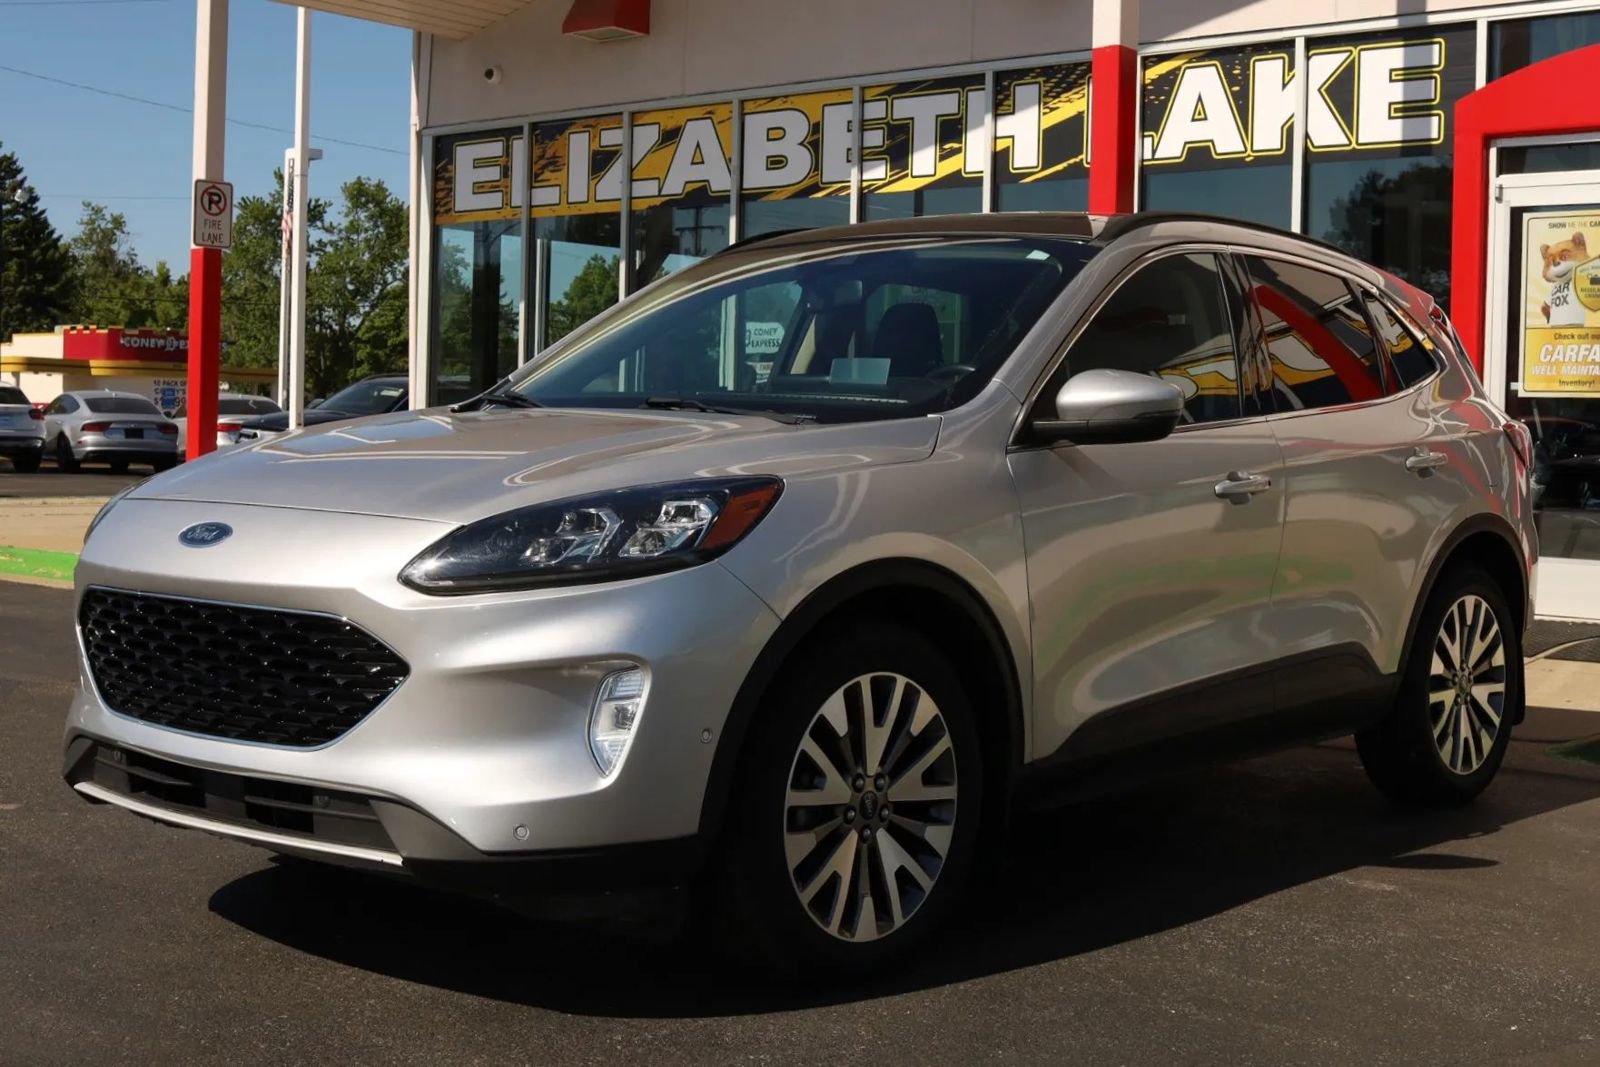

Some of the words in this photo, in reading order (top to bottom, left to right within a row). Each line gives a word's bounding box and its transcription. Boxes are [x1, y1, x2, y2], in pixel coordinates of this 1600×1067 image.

[453, 80, 1043, 213] ELIZABETH
[203, 219, 222, 231] FIRE
[201, 231, 224, 244] LANE
[1550, 294, 1569, 307] FOX
[753, 327, 778, 336] CONEY
[751, 338, 782, 348] EXPRESS
